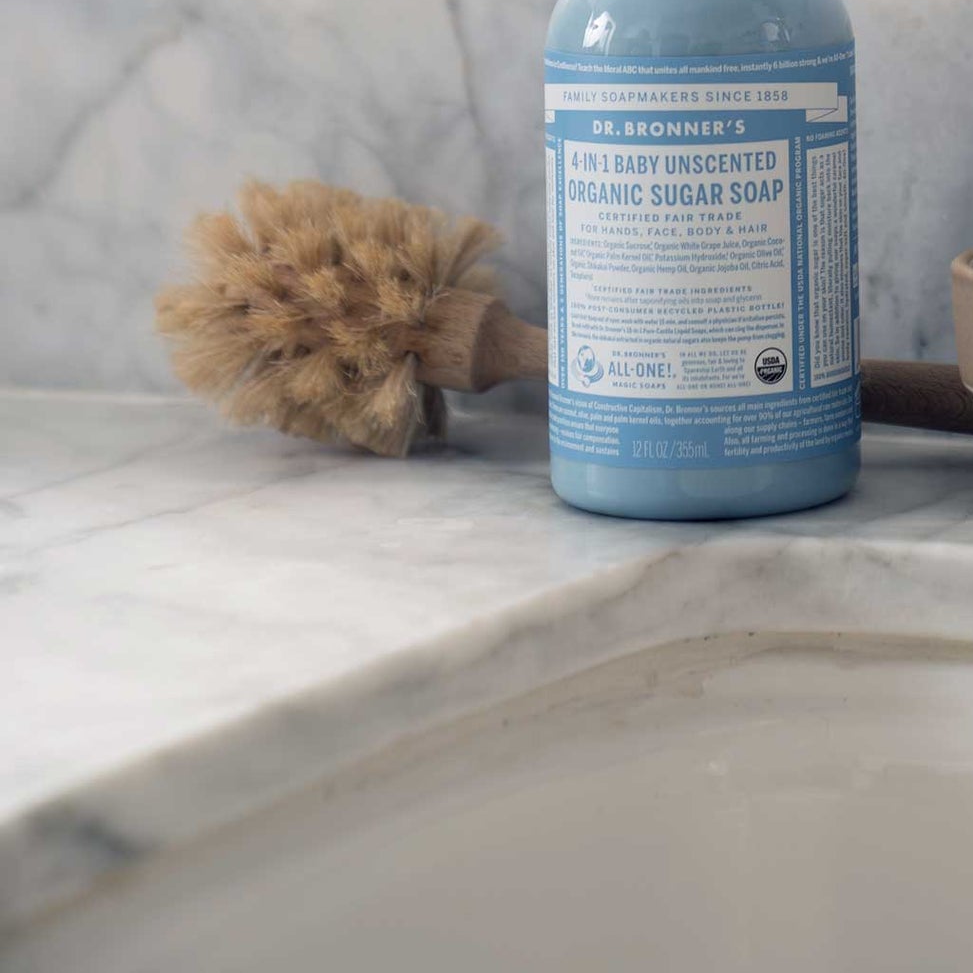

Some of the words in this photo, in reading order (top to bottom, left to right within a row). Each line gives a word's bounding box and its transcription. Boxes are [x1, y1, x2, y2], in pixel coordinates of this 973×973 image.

[622, 66, 637, 75] ABC
[638, 67, 654, 75] that
[689, 64, 722, 74] mankind
[741, 62, 772, 72] instantly
[799, 58, 817, 68] strong
[563, 90, 597, 103] FAMILY
[601, 91, 699, 103] SOAPMAKERS
[705, 90, 752, 102] SINCE
[757, 89, 789, 102] 1858
[593, 120, 621, 136] DR.
[624, 119, 746, 136] BRONNER'S
[571, 151, 610, 173] 4-IN-1
[614, 154, 660, 175] BABY
[665, 150, 777, 175] UNSCENTED
[794, 136, 802, 179] PROGRAM
[568, 178, 643, 206] ORGANIC
[650, 182, 723, 207] SUGAR
[729, 178, 784, 205] SOAP
[795, 181, 803, 221] ORGANIC
[598, 212, 660, 223] CERTIFIED
[665, 213, 693, 223] FAIR
[698, 211, 743, 222] TRADE
[580, 223, 598, 234] FOR
[601, 224, 644, 237] HANDS,
[647, 227, 682, 238] FACE,
[687, 226, 721, 236] BODY
[725, 225, 734, 235] &
[738, 224, 768, 234] HAIR
[681, 242, 700, 250] White
[701, 241, 721, 251] Grape
[796, 222, 804, 266] NATIONAL
[689, 264, 715, 274] Organic
[635, 287, 655, 295] FAIR
[658, 287, 686, 295] TRADE
[690, 285, 752, 295] INGREDIENTS
[588, 304, 654, 315] POST-CONSUMER
[657, 307, 704, 315] RECYCLED
[708, 306, 746, 315] PLASTIC
[762, 356, 780, 365] USDA
[798, 344, 806, 390] CERTIFIED
[612, 381, 637, 389] MAGIC
[640, 382, 666, 390] SOAPS
[632, 440, 642, 458] 12
[644, 440, 654, 458] FL
[655, 440, 669, 459] OZ
